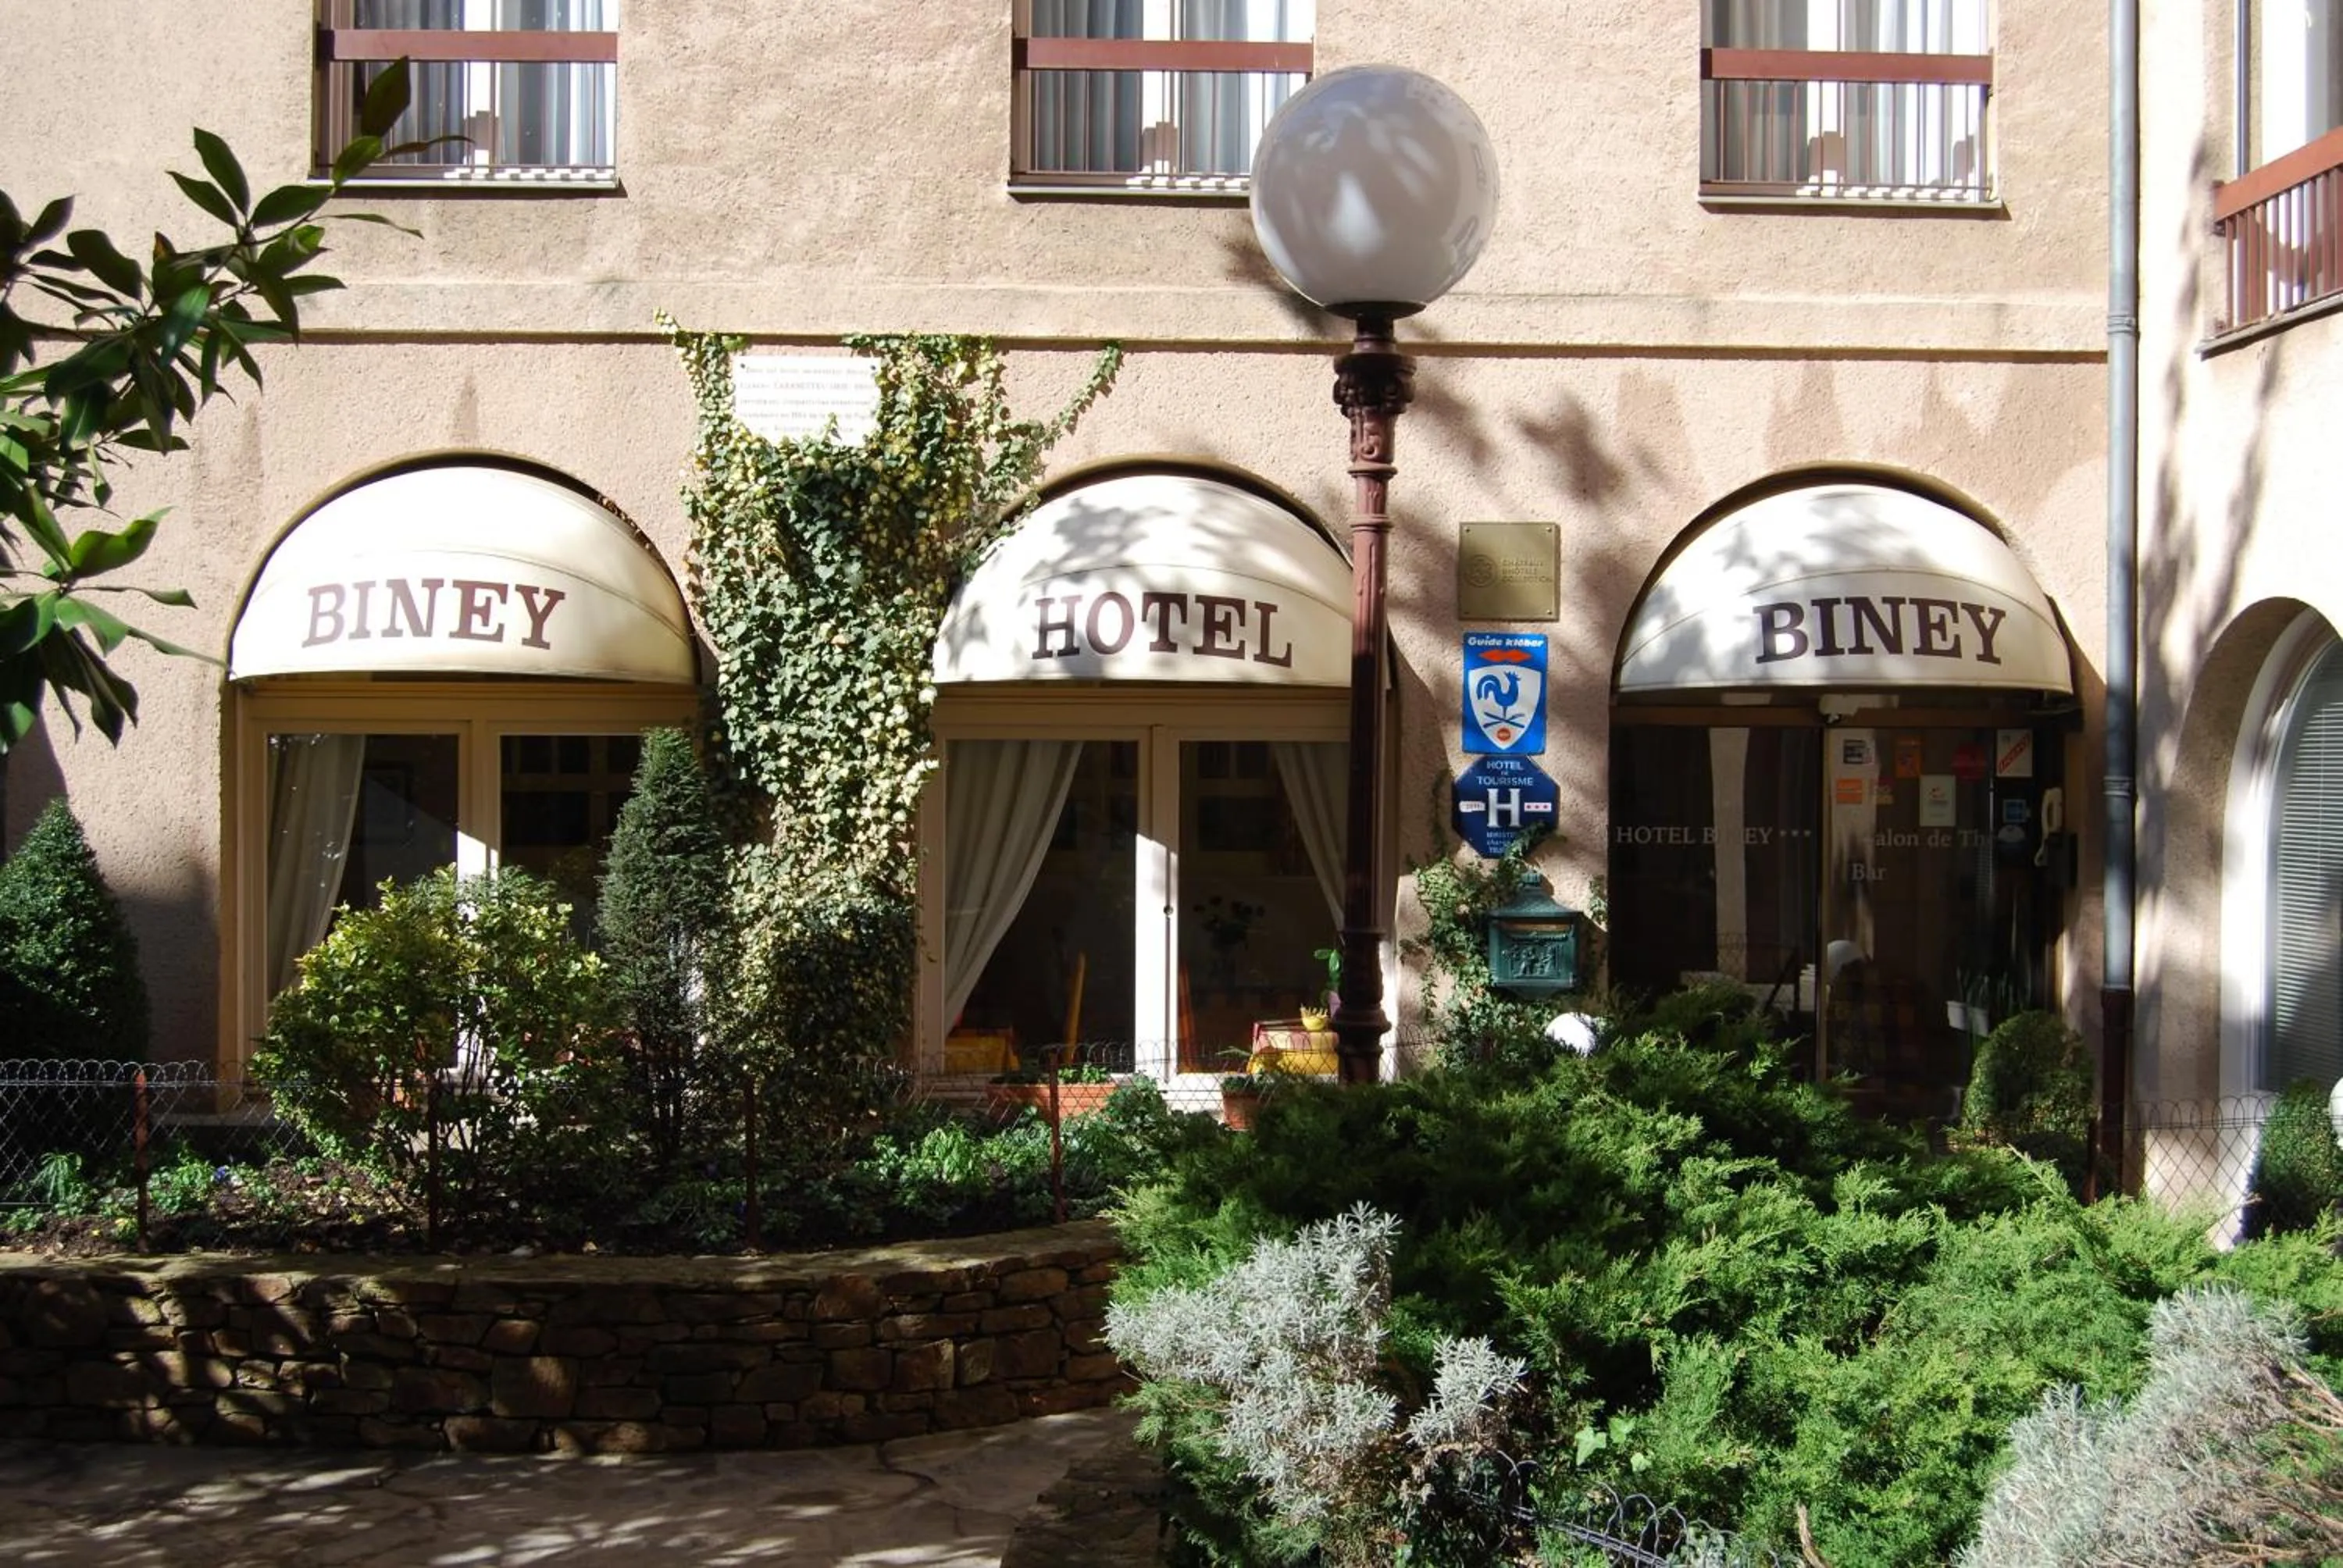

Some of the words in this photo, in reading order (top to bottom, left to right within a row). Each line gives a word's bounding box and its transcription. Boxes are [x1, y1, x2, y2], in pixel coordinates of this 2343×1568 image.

[301, 578, 565, 650] BINEY
[1032, 591, 1292, 668] HOTEL
[1753, 596, 2006, 665] BINEY
[1467, 635, 1503, 646] Guide
[1476, 776, 1534, 786] TOURISME
[1487, 788, 1521, 829] H
[1615, 826, 1696, 844] HOTEL
[1703, 826, 1773, 844] BEY
[1927, 829, 1952, 847] de
[1851, 863, 1888, 881] Bar
